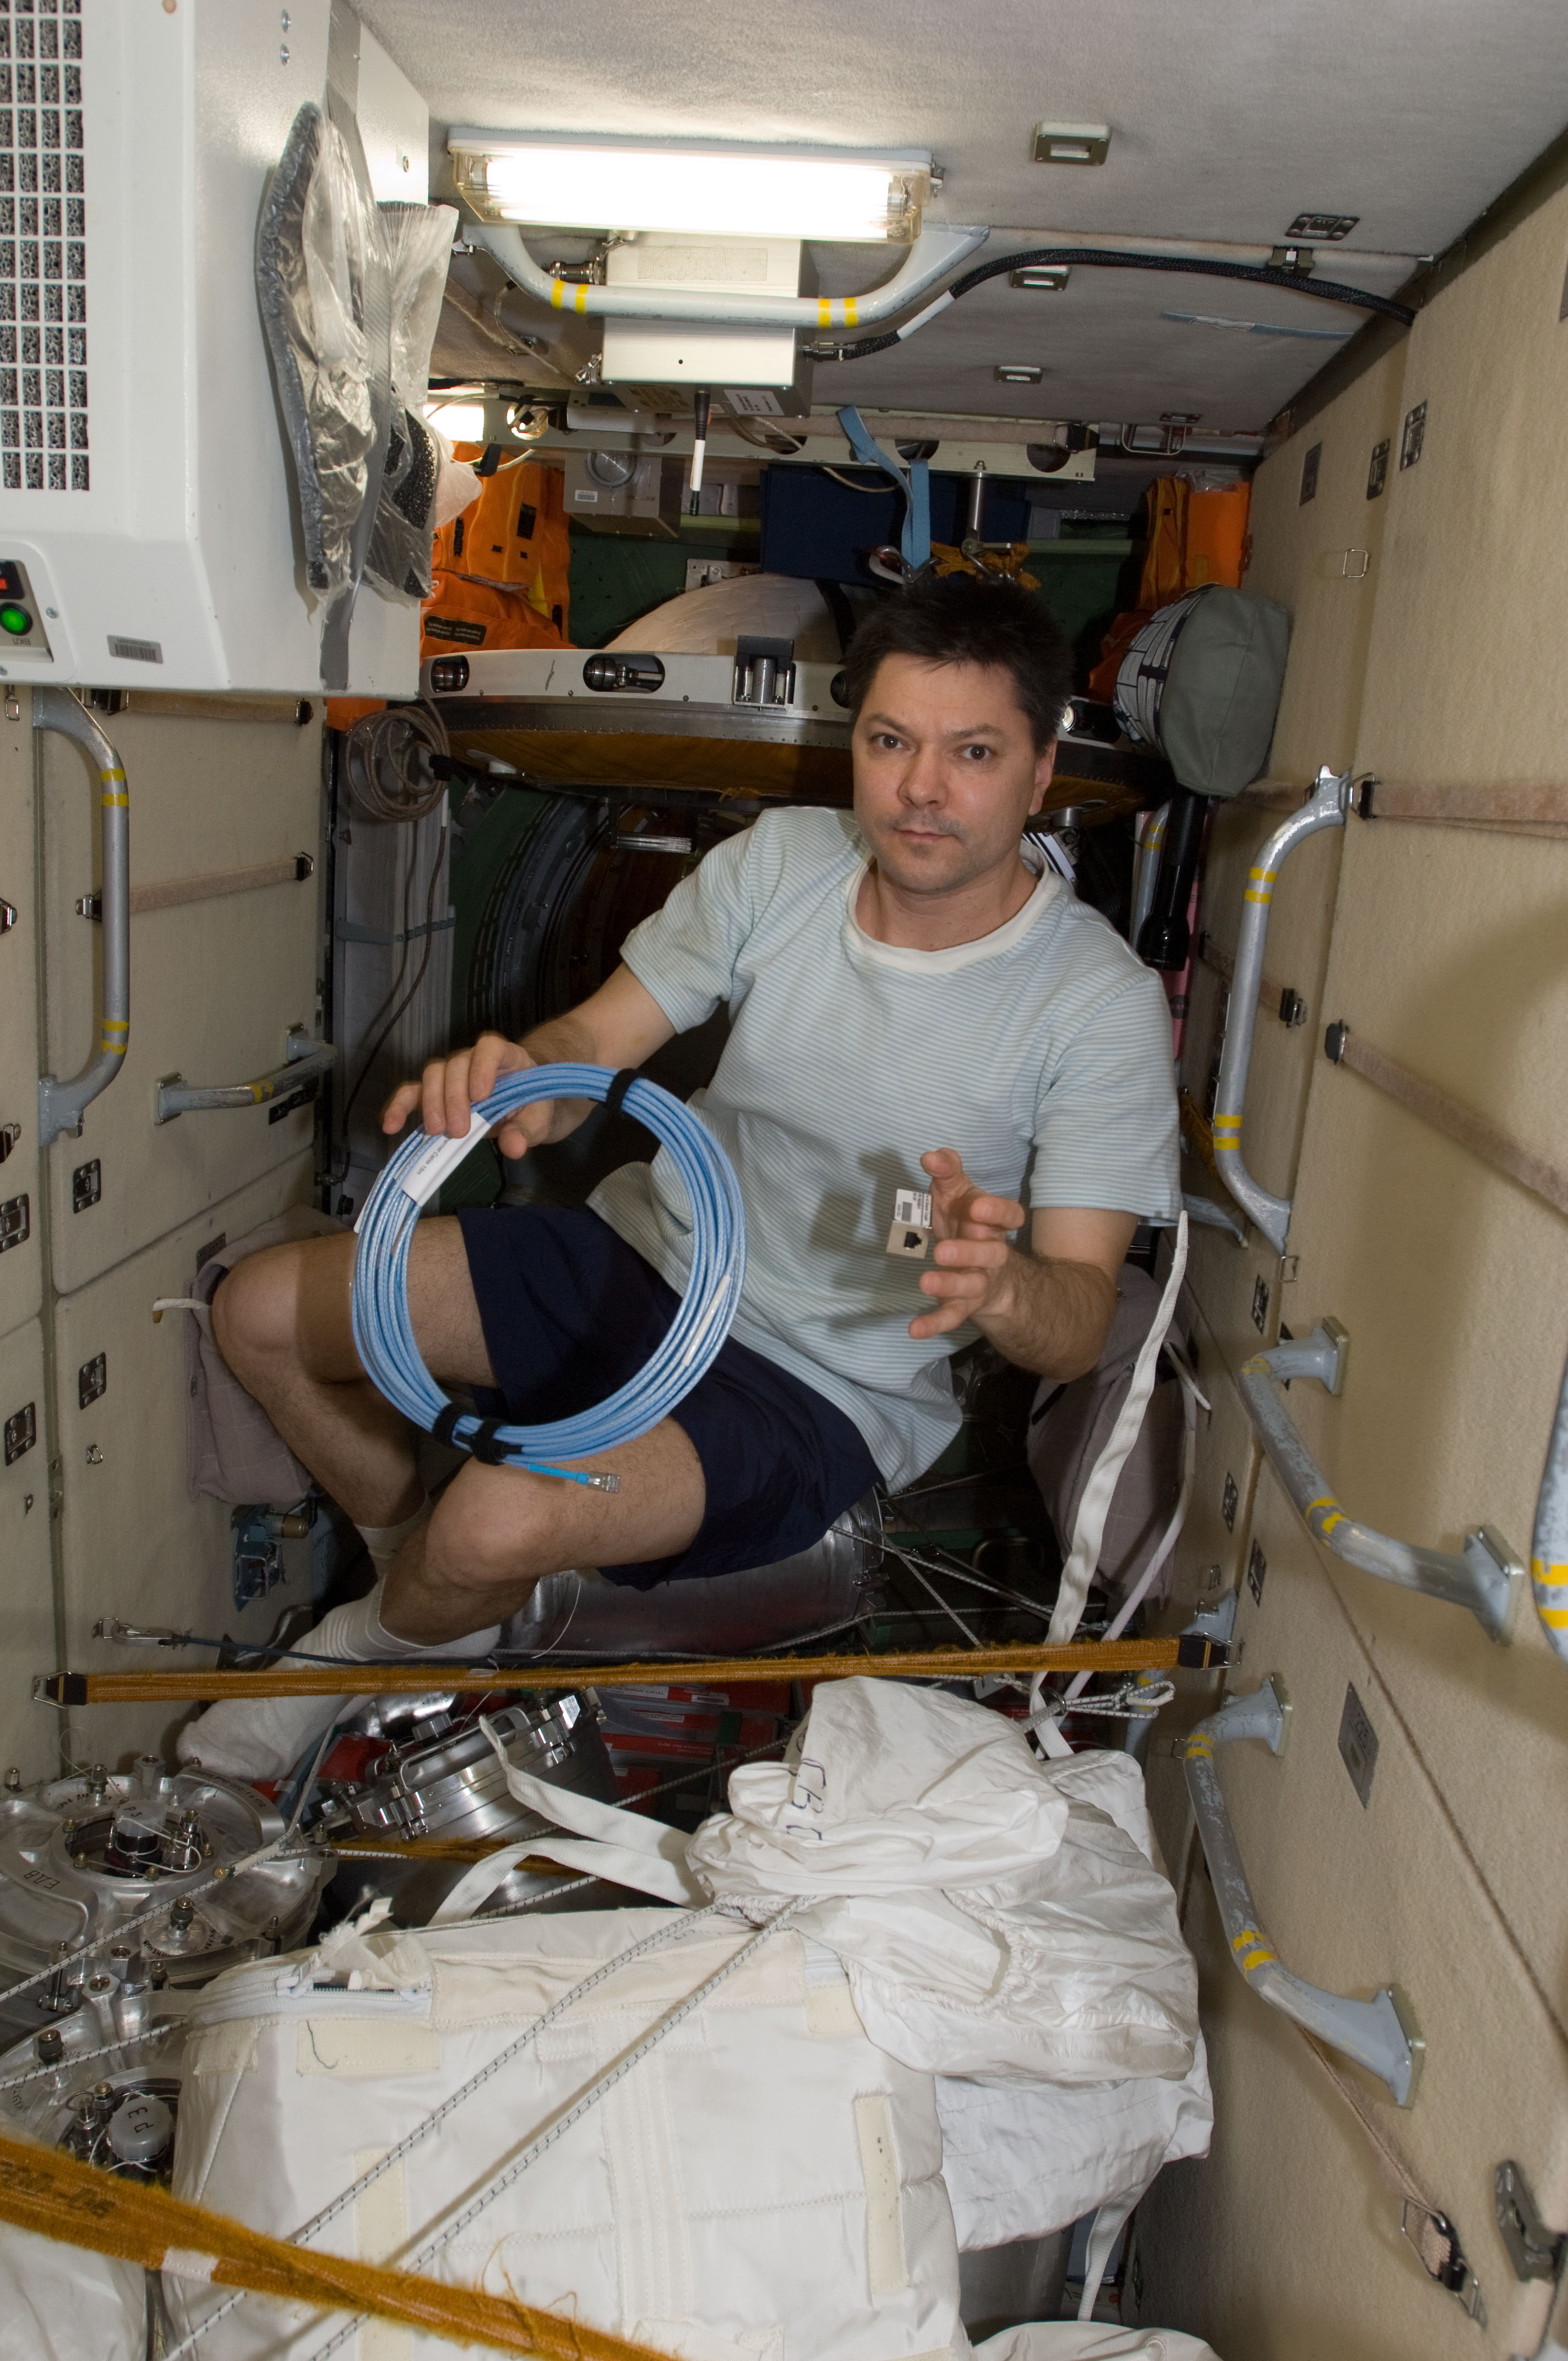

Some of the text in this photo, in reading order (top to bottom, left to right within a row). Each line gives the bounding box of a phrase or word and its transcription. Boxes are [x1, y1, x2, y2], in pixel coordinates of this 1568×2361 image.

[416, 1138, 450, 1175] hernet Cable 15m
[24, 1870, 61, 1889] ЕДВ
